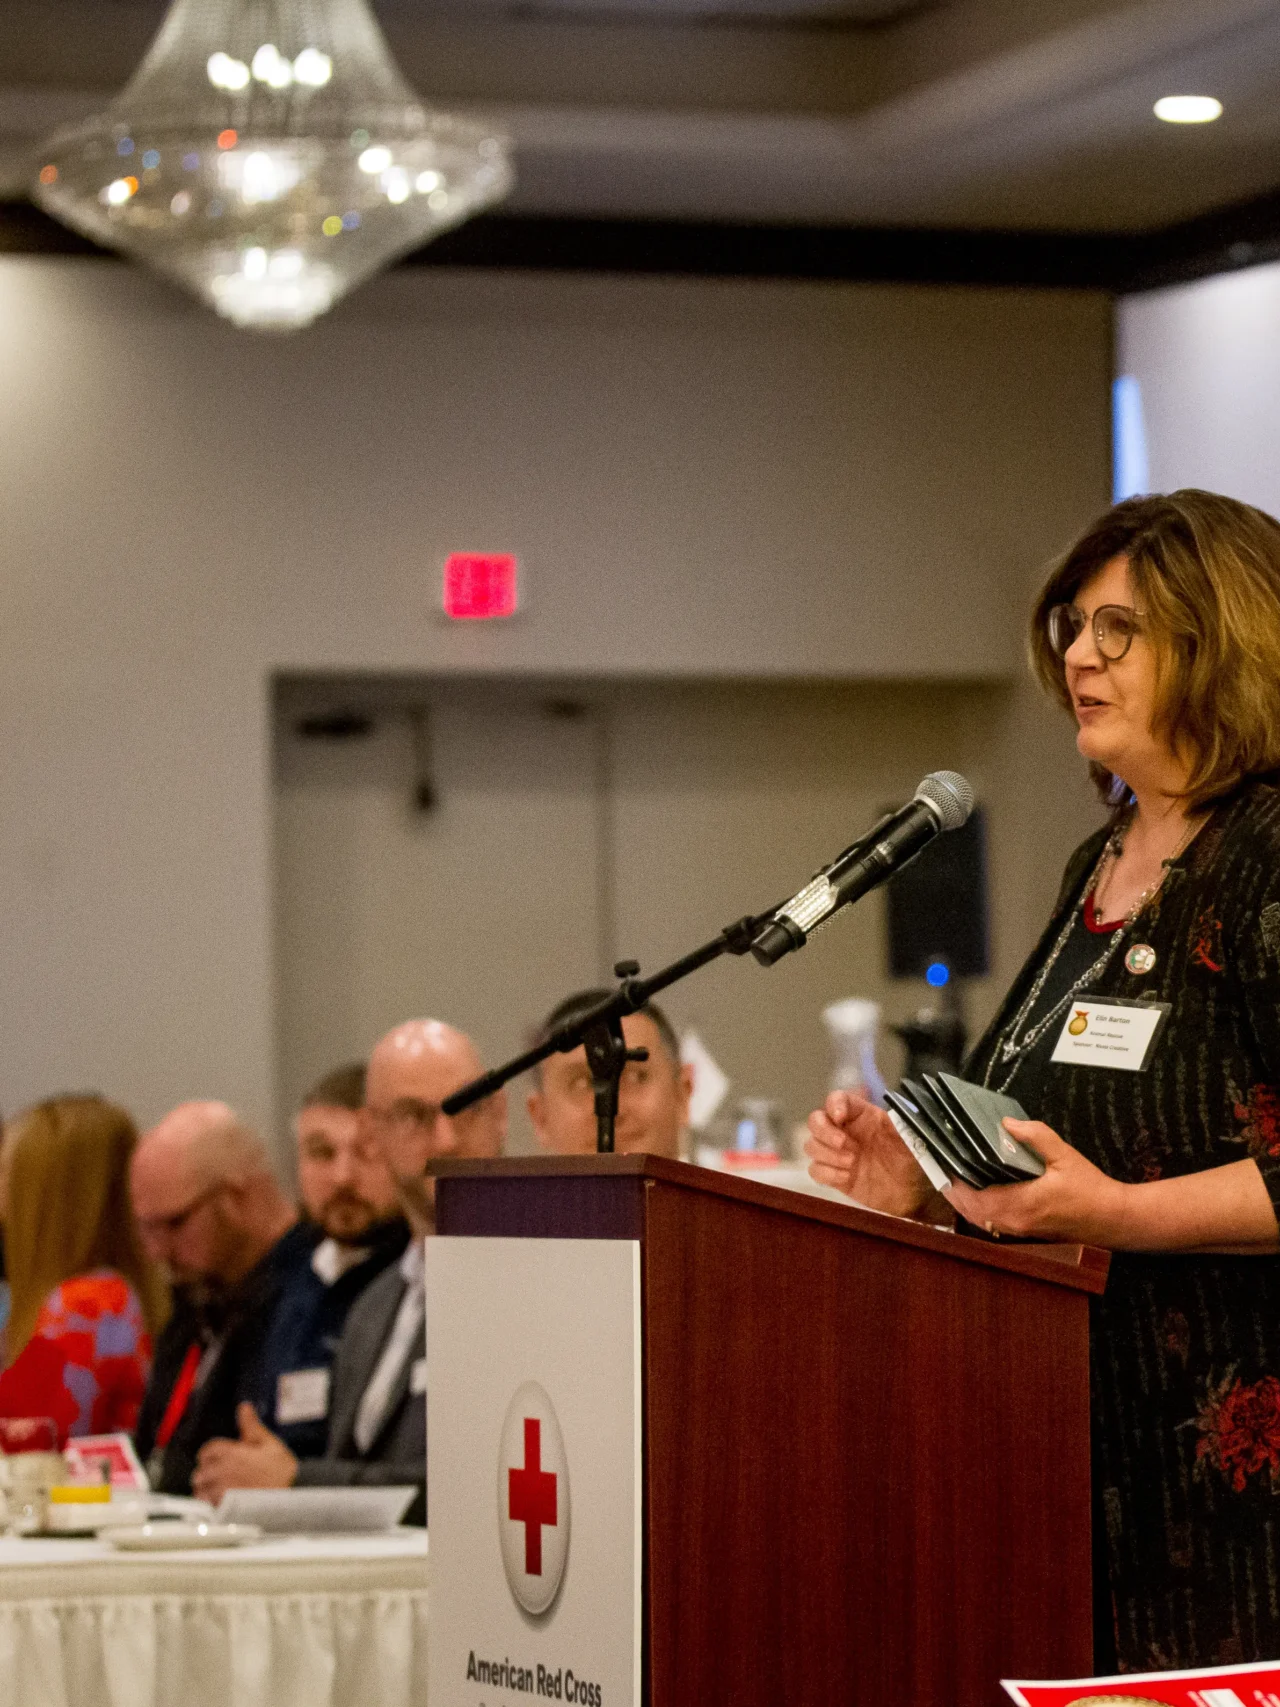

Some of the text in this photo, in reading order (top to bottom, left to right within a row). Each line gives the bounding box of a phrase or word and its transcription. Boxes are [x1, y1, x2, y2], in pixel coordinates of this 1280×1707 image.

[1108, 1016, 1131, 1024] Barton
[466, 1650, 602, 1707] American Red Cross
